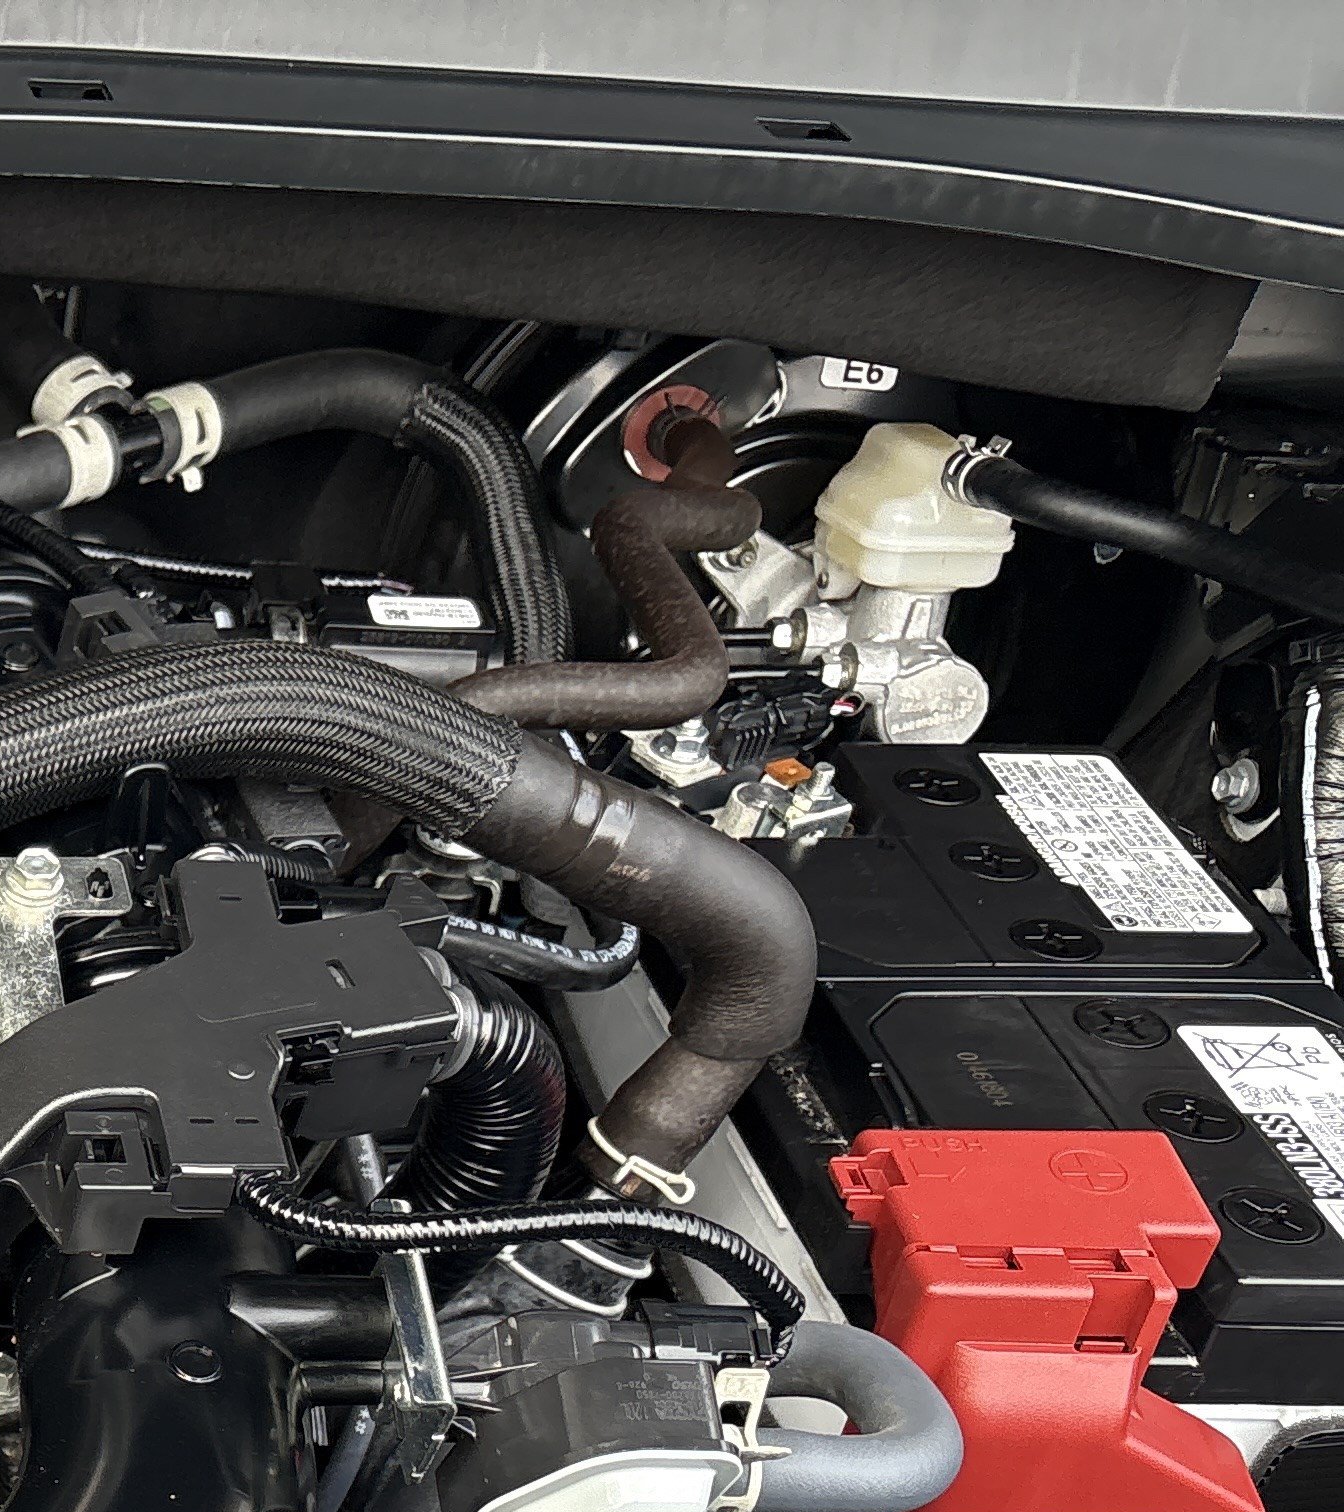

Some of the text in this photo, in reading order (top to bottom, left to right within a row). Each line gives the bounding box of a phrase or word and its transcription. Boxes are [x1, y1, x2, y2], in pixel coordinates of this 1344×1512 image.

[843, 360, 884, 385] E6
[1300, 1046, 1330, 1064] Pb
[899, 1136, 988, 1153] PUSH
